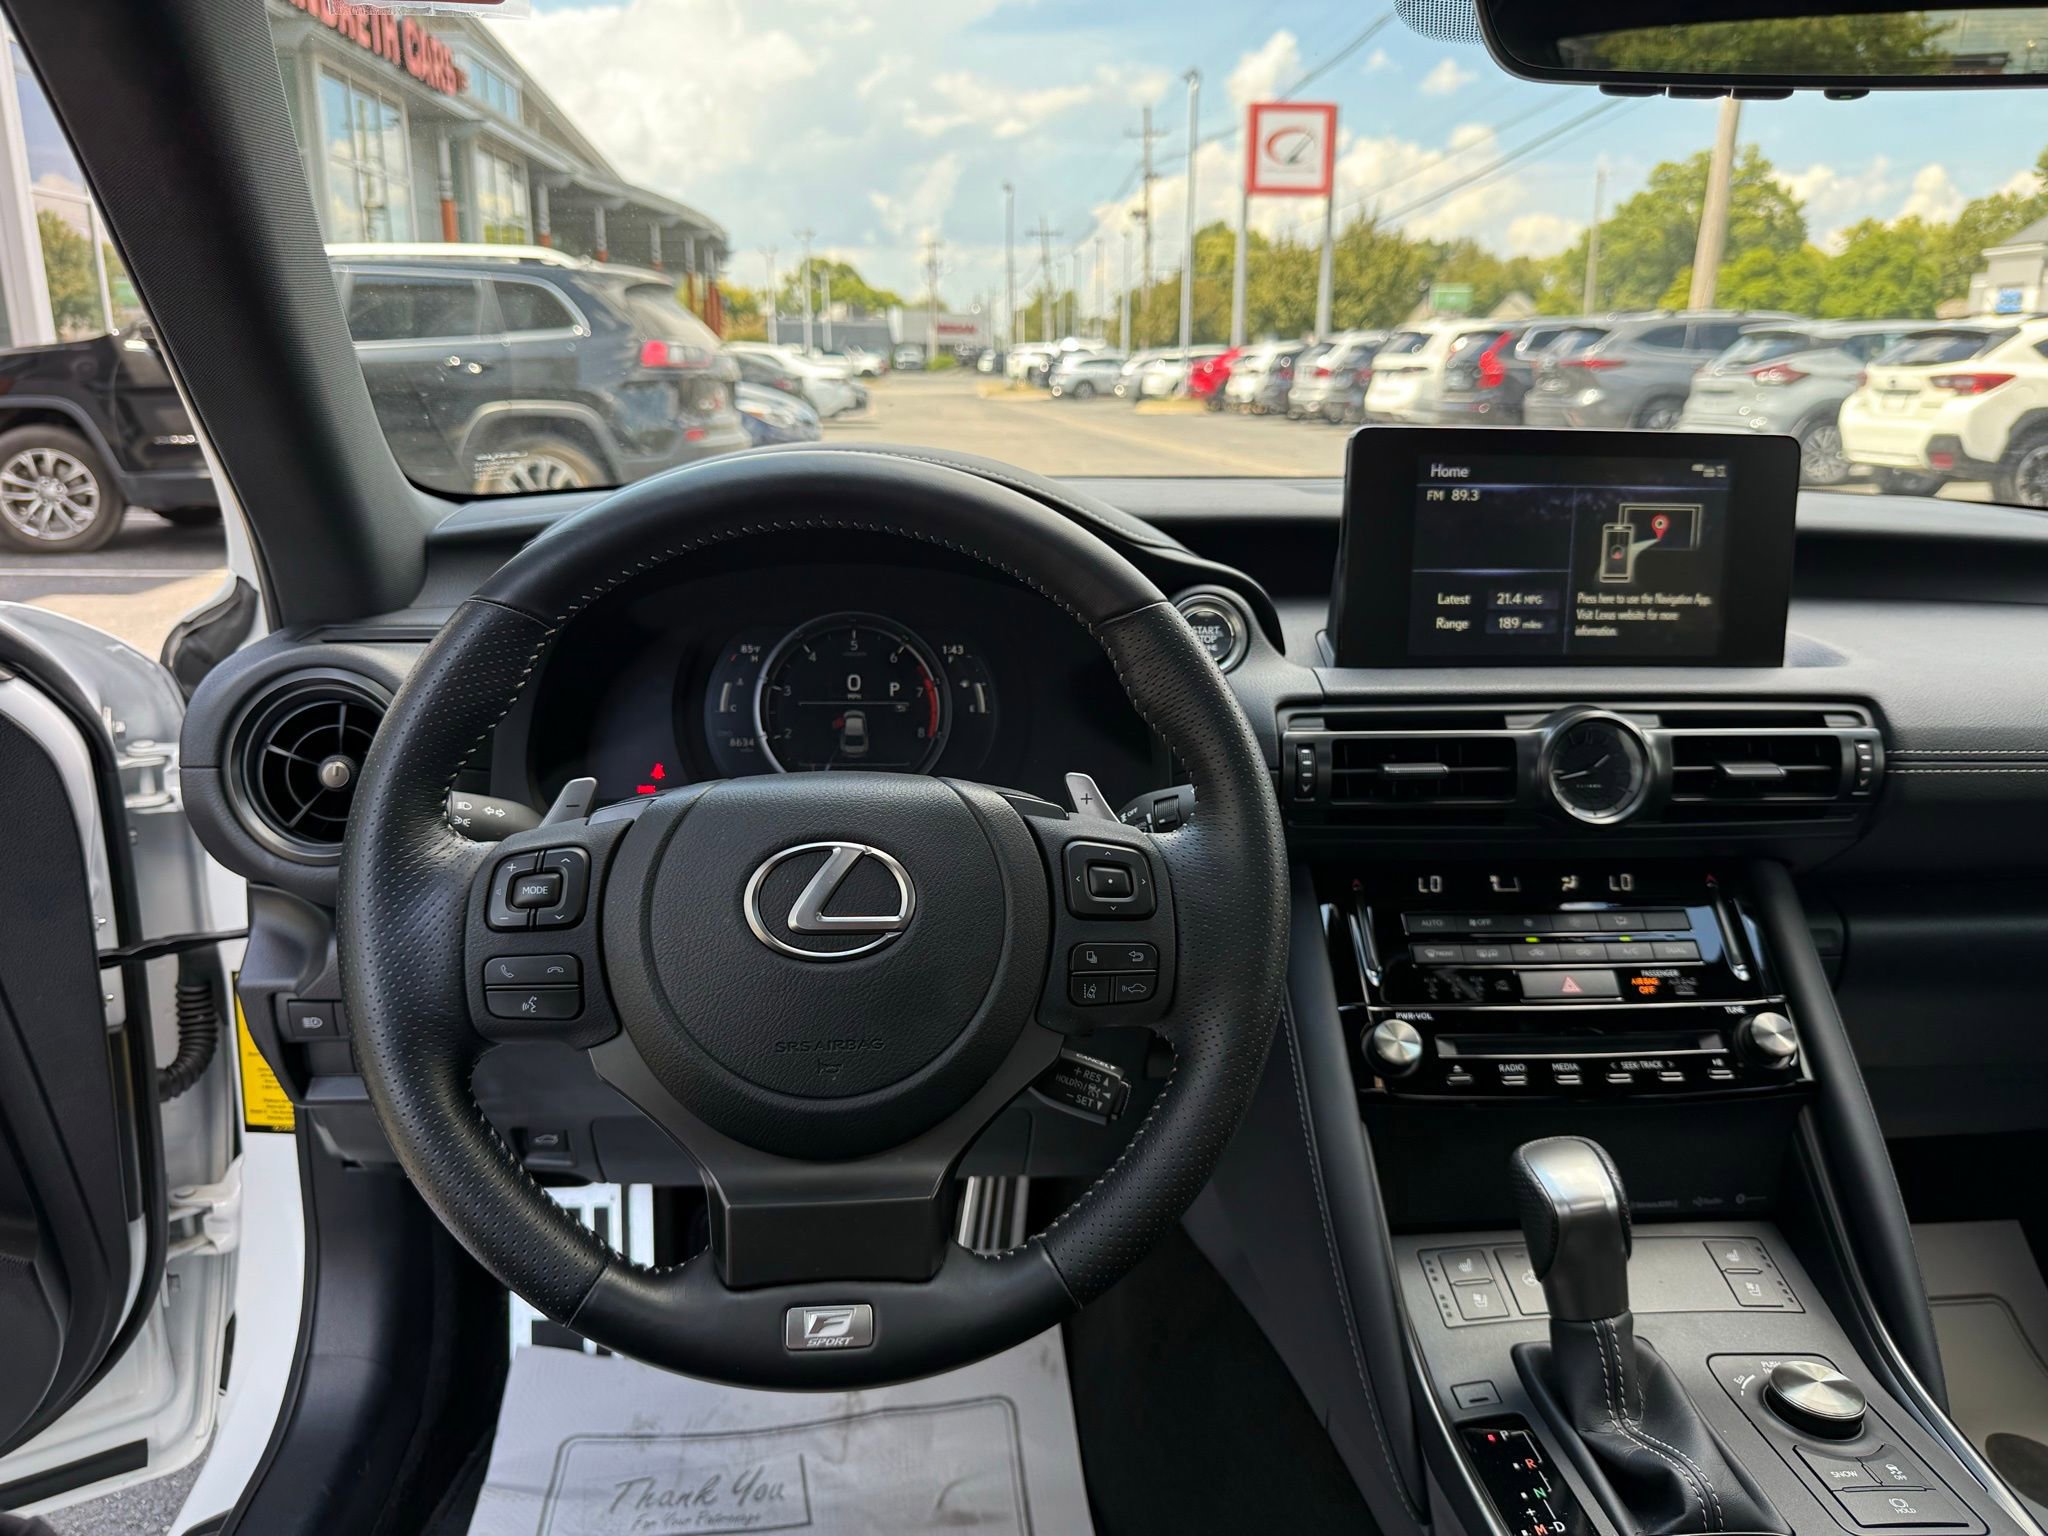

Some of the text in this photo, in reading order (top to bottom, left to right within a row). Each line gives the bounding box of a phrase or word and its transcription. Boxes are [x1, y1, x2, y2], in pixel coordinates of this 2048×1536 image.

[1430, 463, 1470, 478] Home
[1426, 488, 1480, 501] FM 89.3
[1437, 593, 1471, 605] Latest
[1496, 592, 1522, 605] 21.4
[1577, 592, 1597, 604] Press
[1598, 593, 1615, 604] here
[1616, 594, 1625, 604] to
[1626, 595, 1640, 604] use
[1641, 592, 1653, 604] the
[1576, 609, 1594, 620] Visit
[1595, 609, 1616, 620] Lexus
[1617, 609, 1646, 620] website
[1646, 609, 1658, 620] for
[1436, 617, 1470, 631] Range
[1498, 617, 1521, 629] 189
[1199, 635, 1217, 644] TOP
[850, 641, 858, 651] 5
[942, 645, 964, 655] 1:43
[808, 653, 816, 662] 4
[889, 653, 898, 663] 6
[784, 685, 792, 697] 3
[889, 682, 900, 697] P
[916, 687, 923, 698] 7
[917, 727, 925, 738] 8
[522, 886, 548, 895] MODE
[1421, 919, 1443, 927] AUTO
[1477, 918, 1491, 926] OFF
[1641, 969, 1680, 977] PASSENGER
[1724, 1006, 1746, 1014] TUNE
[775, 1039, 887, 1054] SRS AIRBAG
[1076, 1053, 1109, 1068] CANCEL
[1499, 1064, 1527, 1072] RADIO
[1552, 1063, 1580, 1071] MEDIA
[1056, 1073, 1075, 1086] HOLD
[1083, 1070, 1102, 1083] RES
[1076, 1094, 1094, 1107] SET
[806, 1337, 854, 1347] SPORT
[1500, 1430, 1509, 1440] P
[1525, 1458, 1537, 1469] R
[1830, 1470, 1858, 1478] SNOW
[609, 1465, 785, 1514] Thank You
[1533, 1487, 1547, 1498] N
[1534, 1521, 1566, 1536] M D
